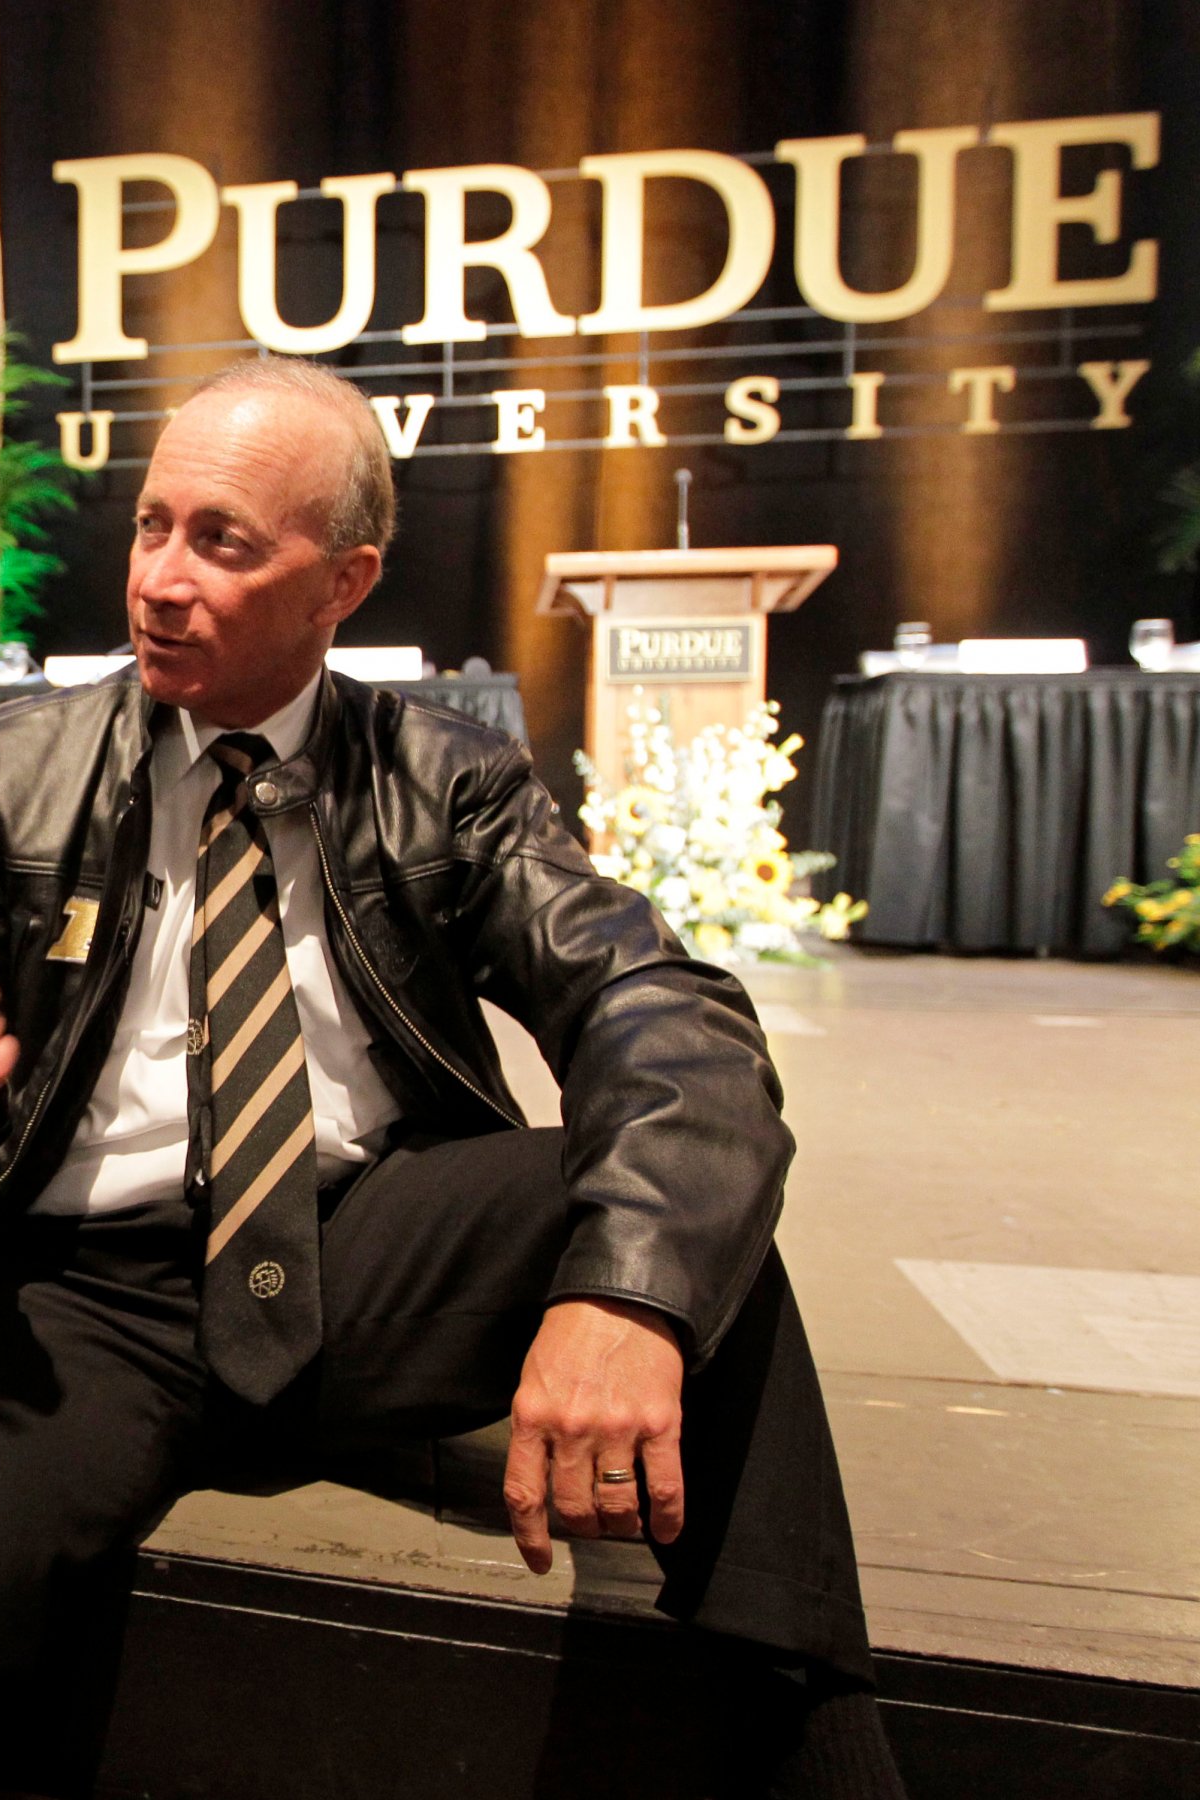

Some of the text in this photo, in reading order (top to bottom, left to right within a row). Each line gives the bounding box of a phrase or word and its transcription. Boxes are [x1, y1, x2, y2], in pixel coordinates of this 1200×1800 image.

[53, 112, 1161, 363] PURDUE
[56, 360, 1151, 472] UVERSITY
[618, 628, 743, 659] PURDUE
